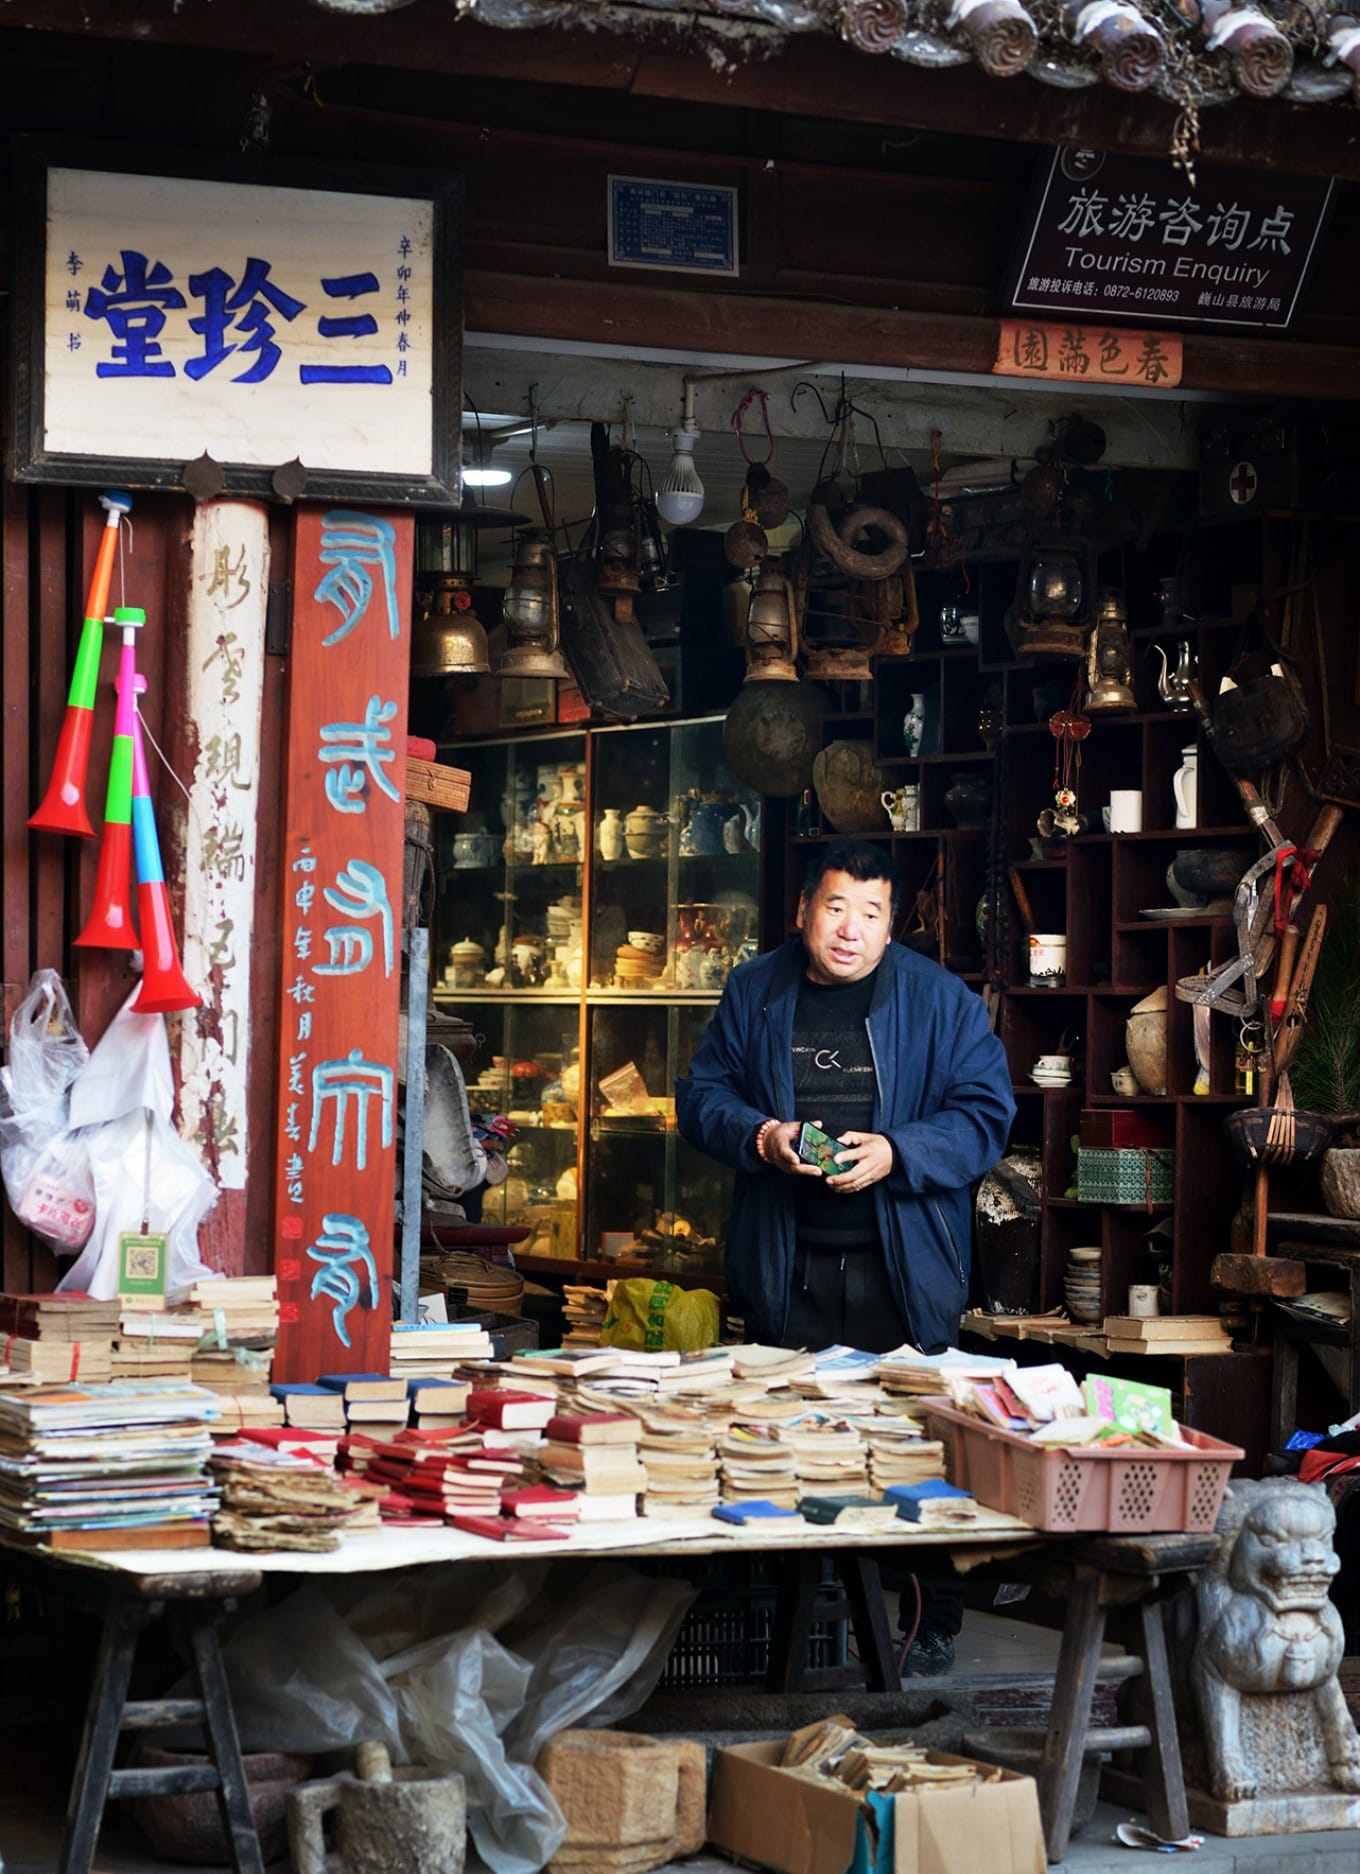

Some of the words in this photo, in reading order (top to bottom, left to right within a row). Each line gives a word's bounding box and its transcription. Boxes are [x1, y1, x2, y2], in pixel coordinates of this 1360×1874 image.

[1057, 186, 1295, 255] 旅游咨询点
[1065, 246, 1168, 276] Tourism
[1172, 256, 1271, 289] Enquiry
[1103, 283, 1180, 303] 0872-6120893
[394, 234, 413, 377] 辛卯年仲春月
